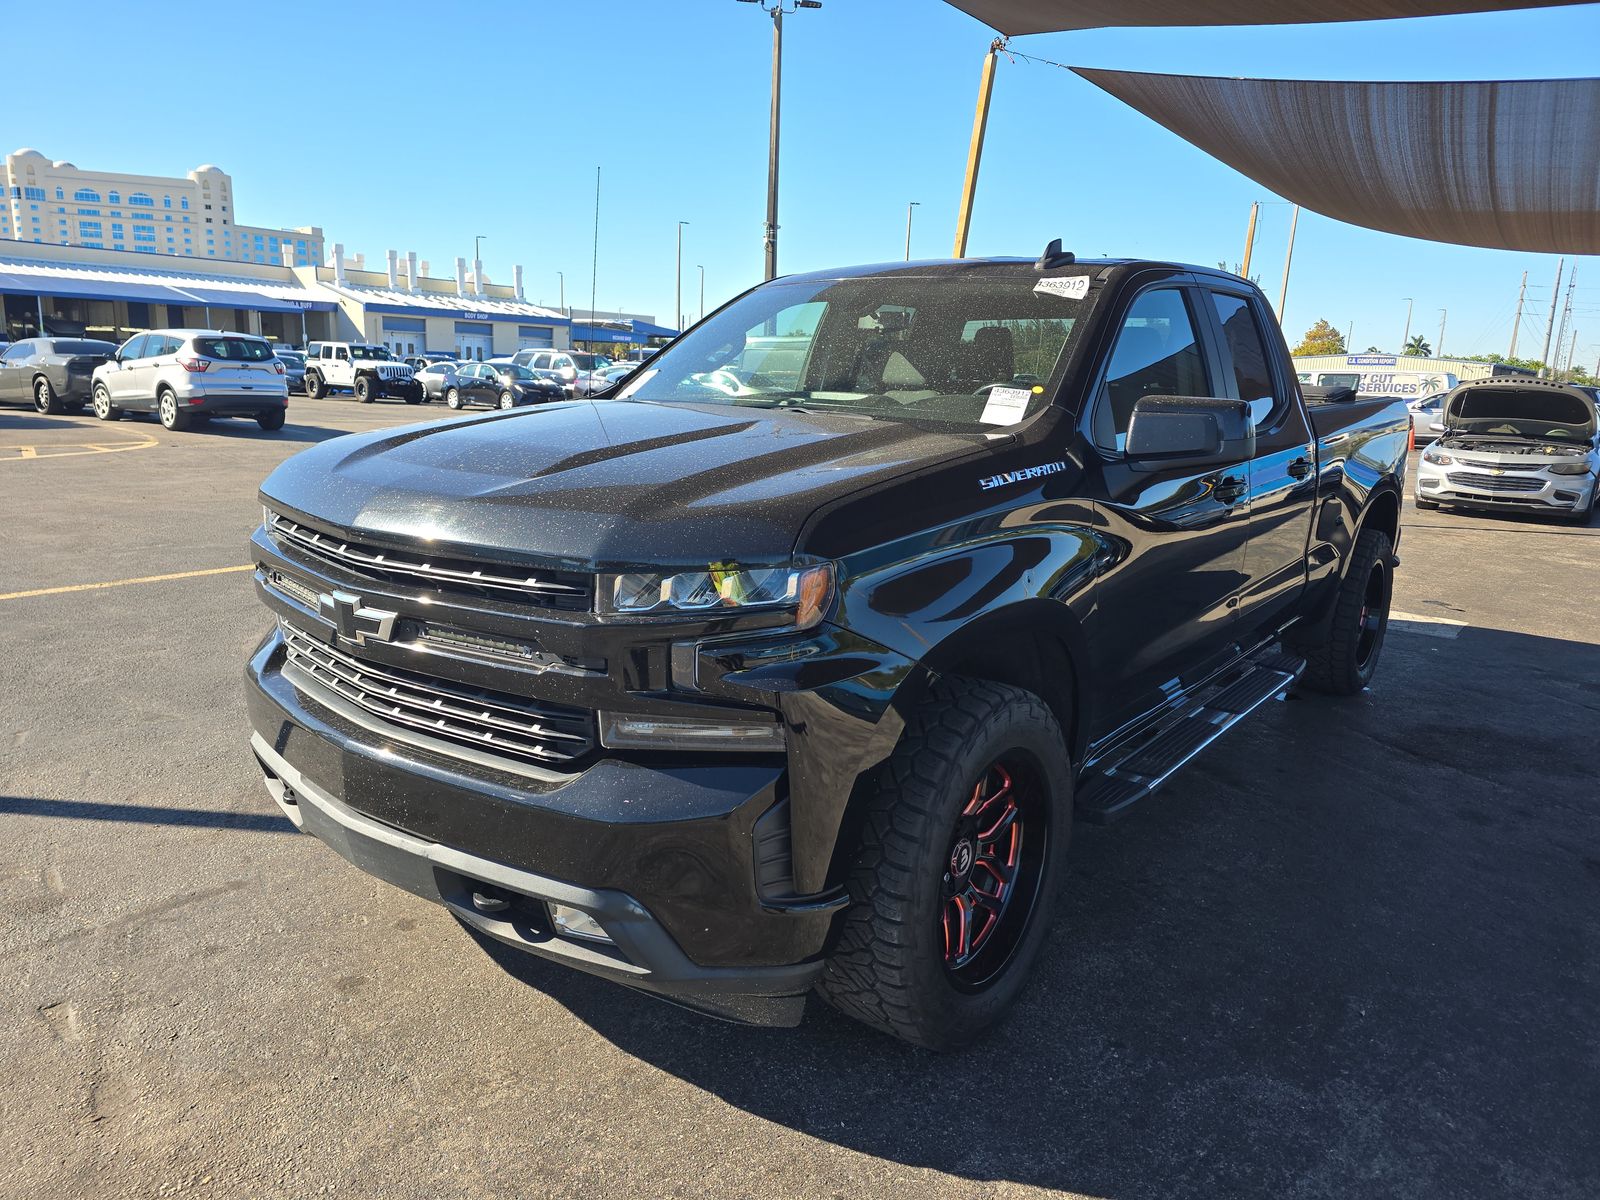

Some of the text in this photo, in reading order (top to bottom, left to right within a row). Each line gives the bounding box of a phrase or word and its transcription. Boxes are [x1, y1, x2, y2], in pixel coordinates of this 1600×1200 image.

[1370, 373, 1396, 383] CUT
[1358, 383, 1417, 394] SERVICES
[979, 461, 1067, 490] SILVERADO
